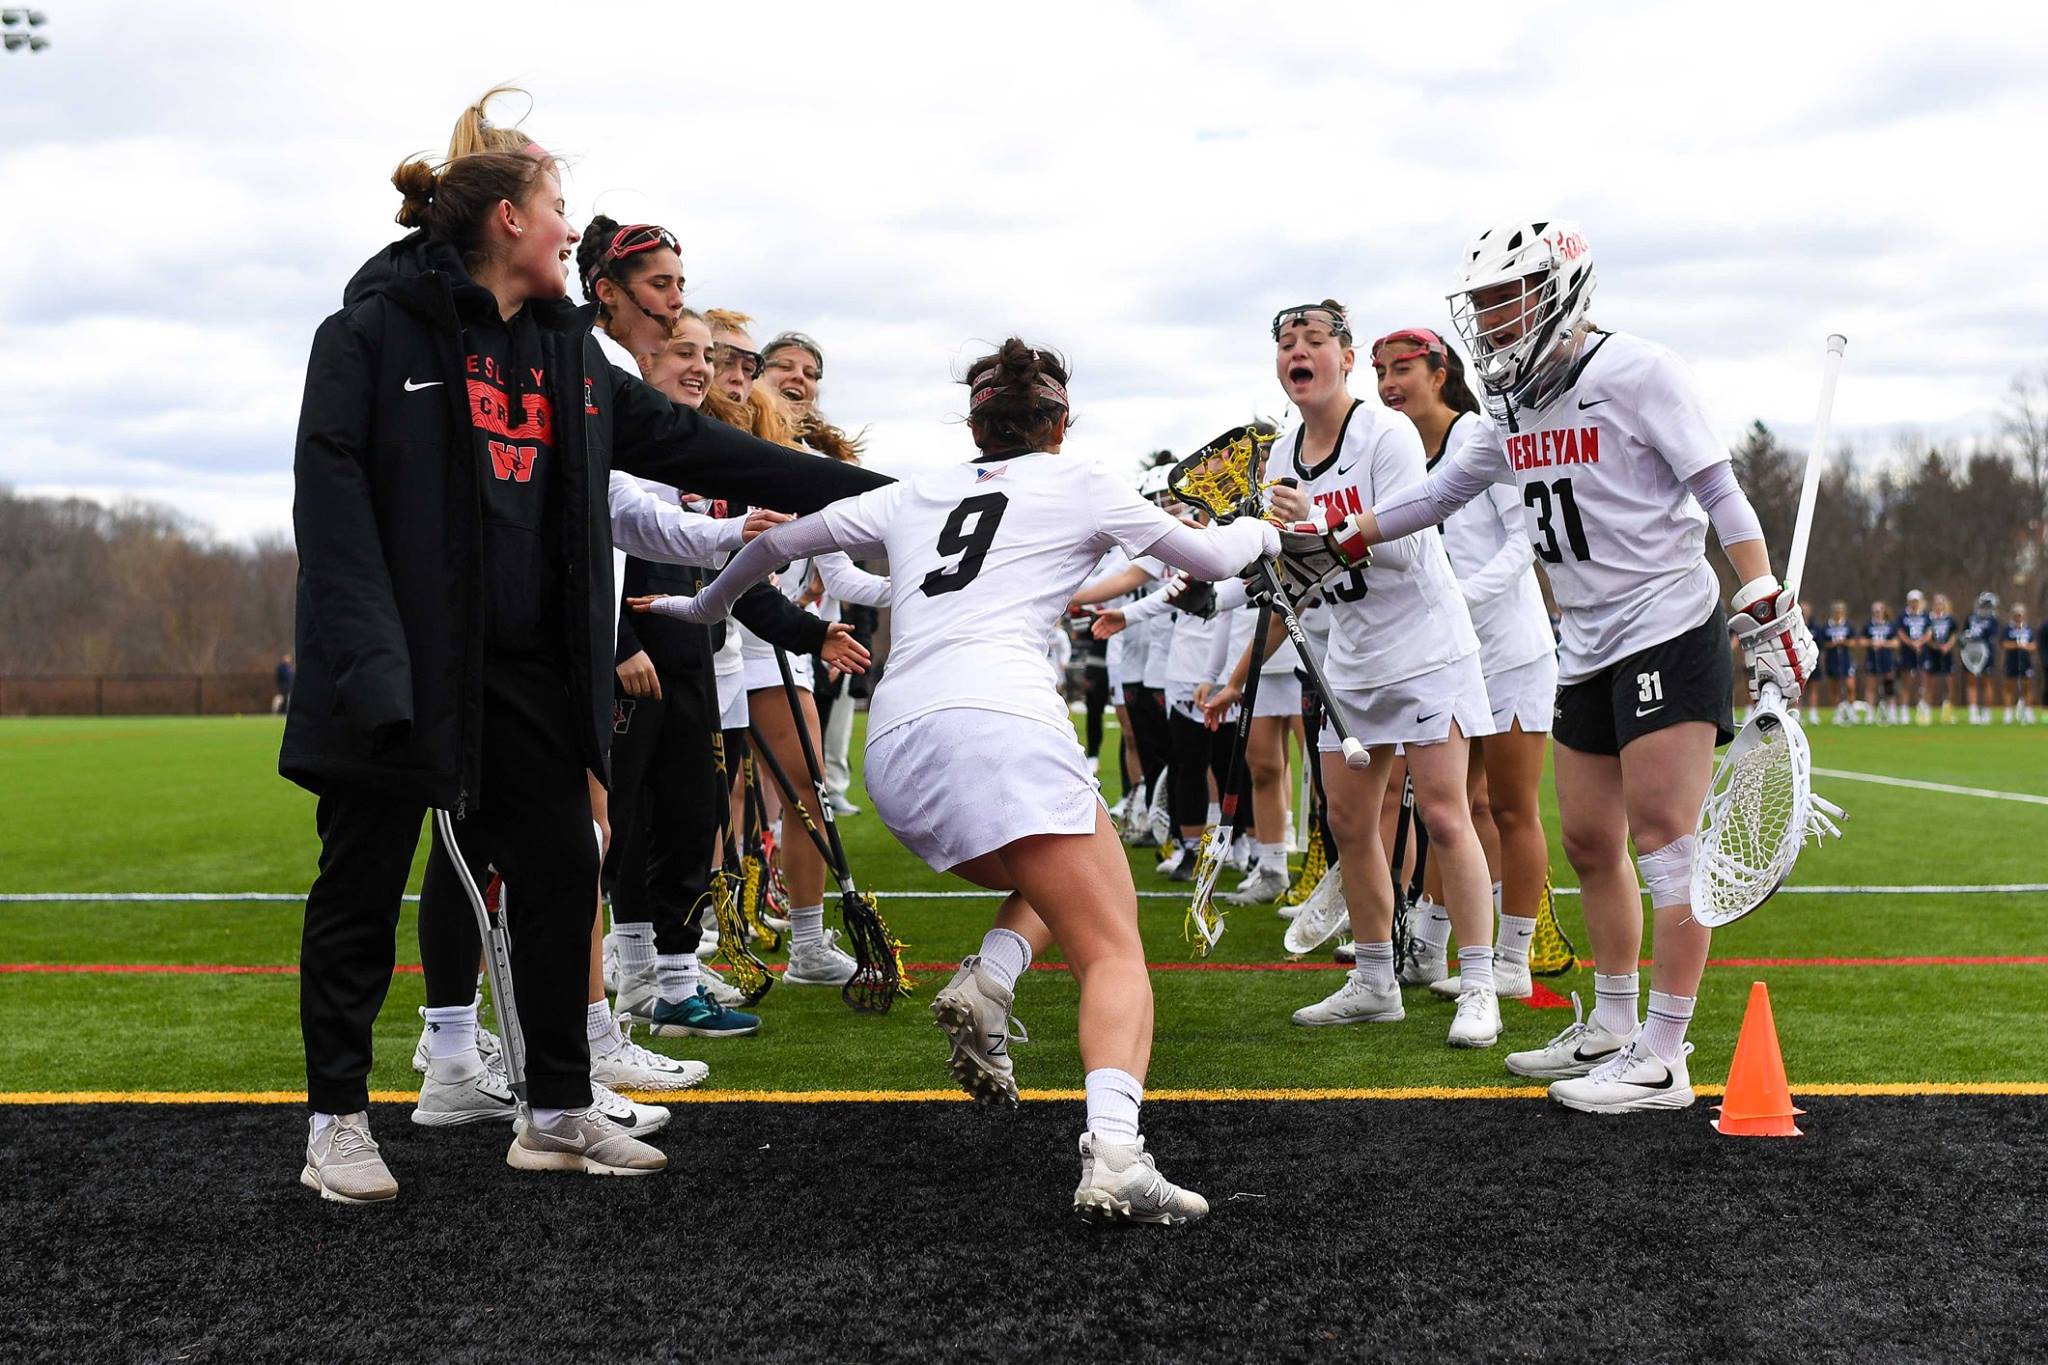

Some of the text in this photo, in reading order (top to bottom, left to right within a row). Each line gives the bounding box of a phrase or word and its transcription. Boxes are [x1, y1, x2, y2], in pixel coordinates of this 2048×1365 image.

[919, 491, 1009, 598] 9
[1524, 478, 1591, 563] 31
[1637, 670, 1663, 702] 31
[813, 780, 834, 822] STX
